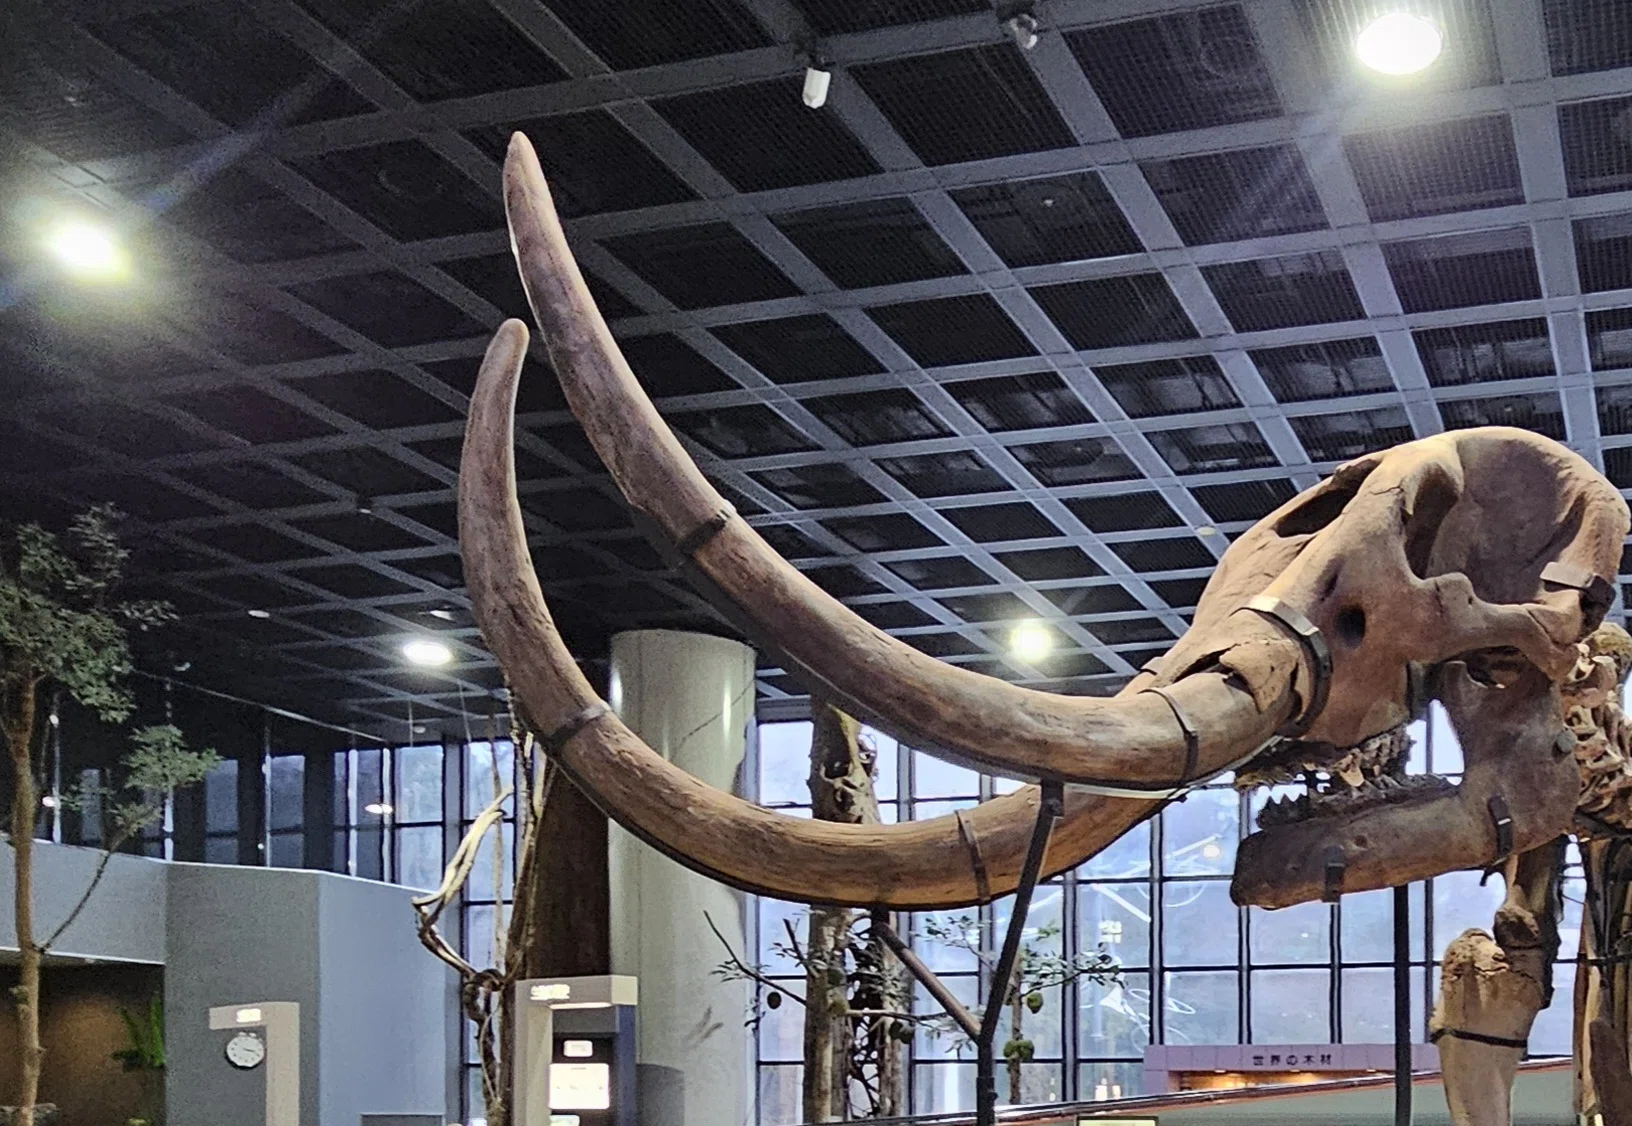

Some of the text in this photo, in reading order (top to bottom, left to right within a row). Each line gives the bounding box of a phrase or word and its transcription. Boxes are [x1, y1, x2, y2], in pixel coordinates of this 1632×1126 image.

[1252, 1053, 1332, 1066] 世界の木材
